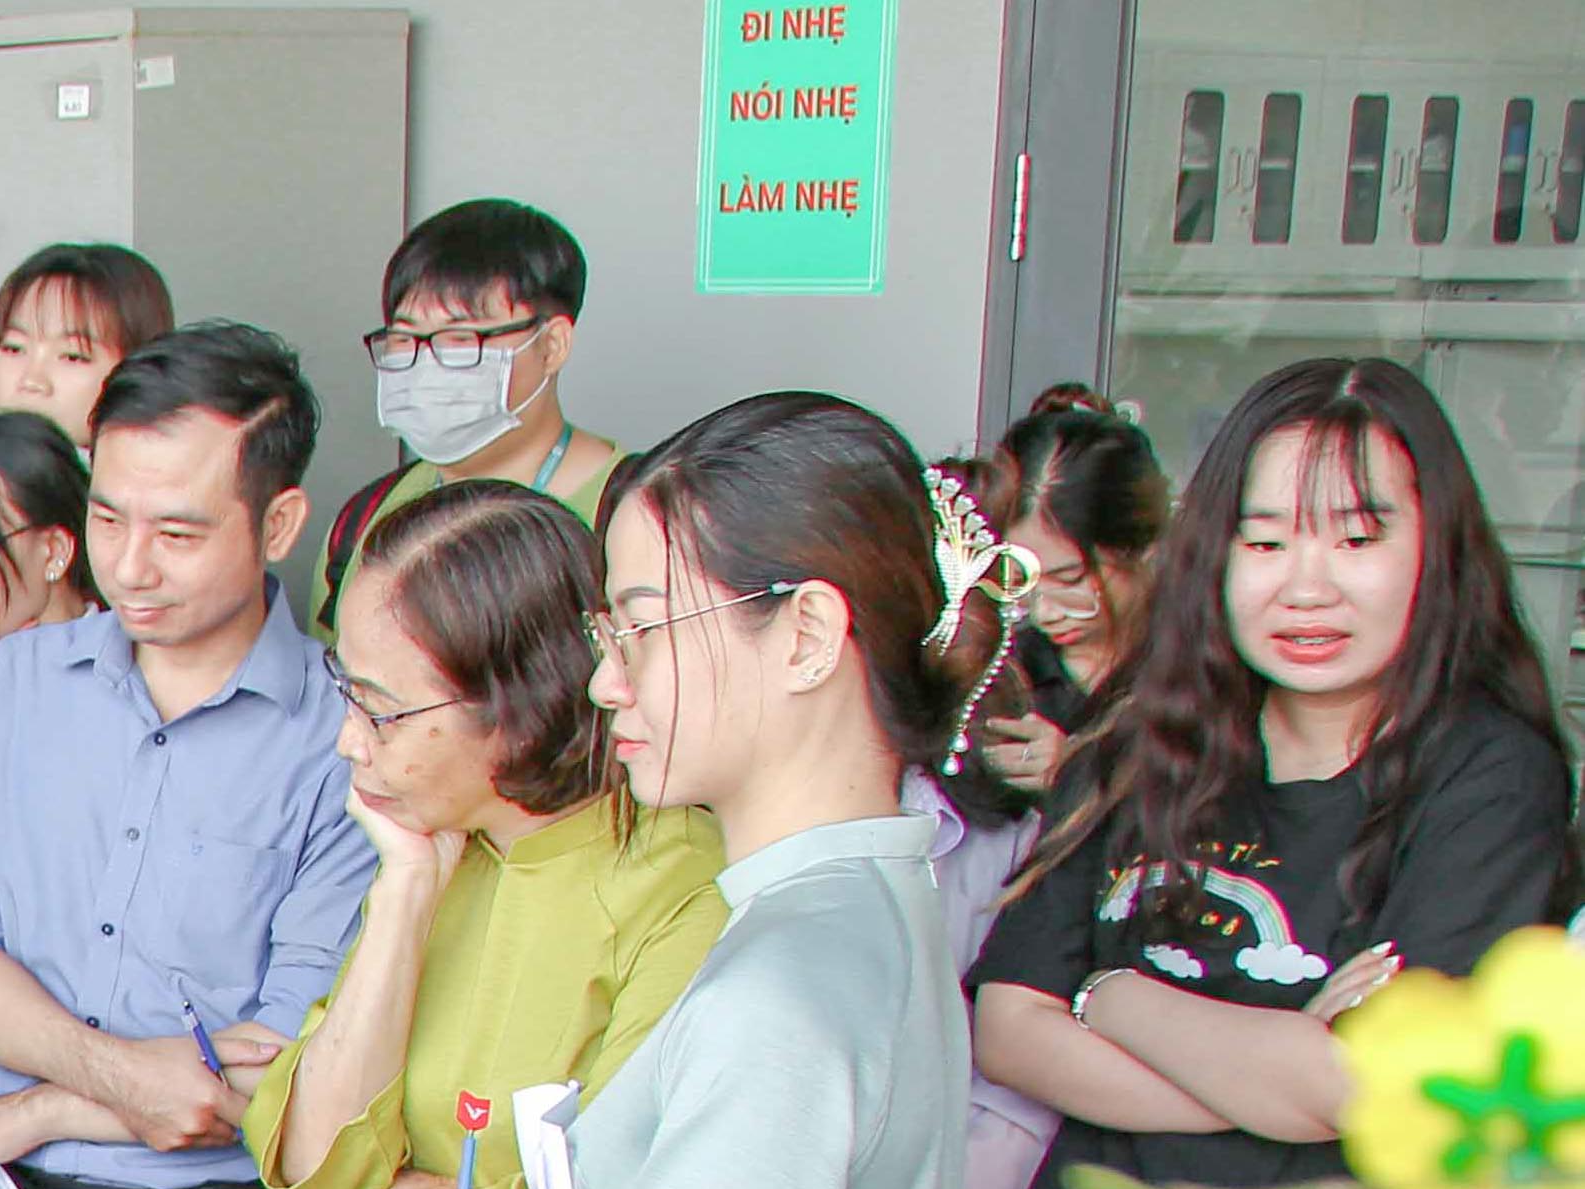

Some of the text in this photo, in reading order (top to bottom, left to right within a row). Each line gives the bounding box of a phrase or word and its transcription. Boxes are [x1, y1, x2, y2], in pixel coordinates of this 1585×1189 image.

[741, 6, 846, 45] ĐI NHẸ
[730, 82, 858, 124] NÓI NHẸ
[719, 174, 859, 217] LÀM NHẸ
